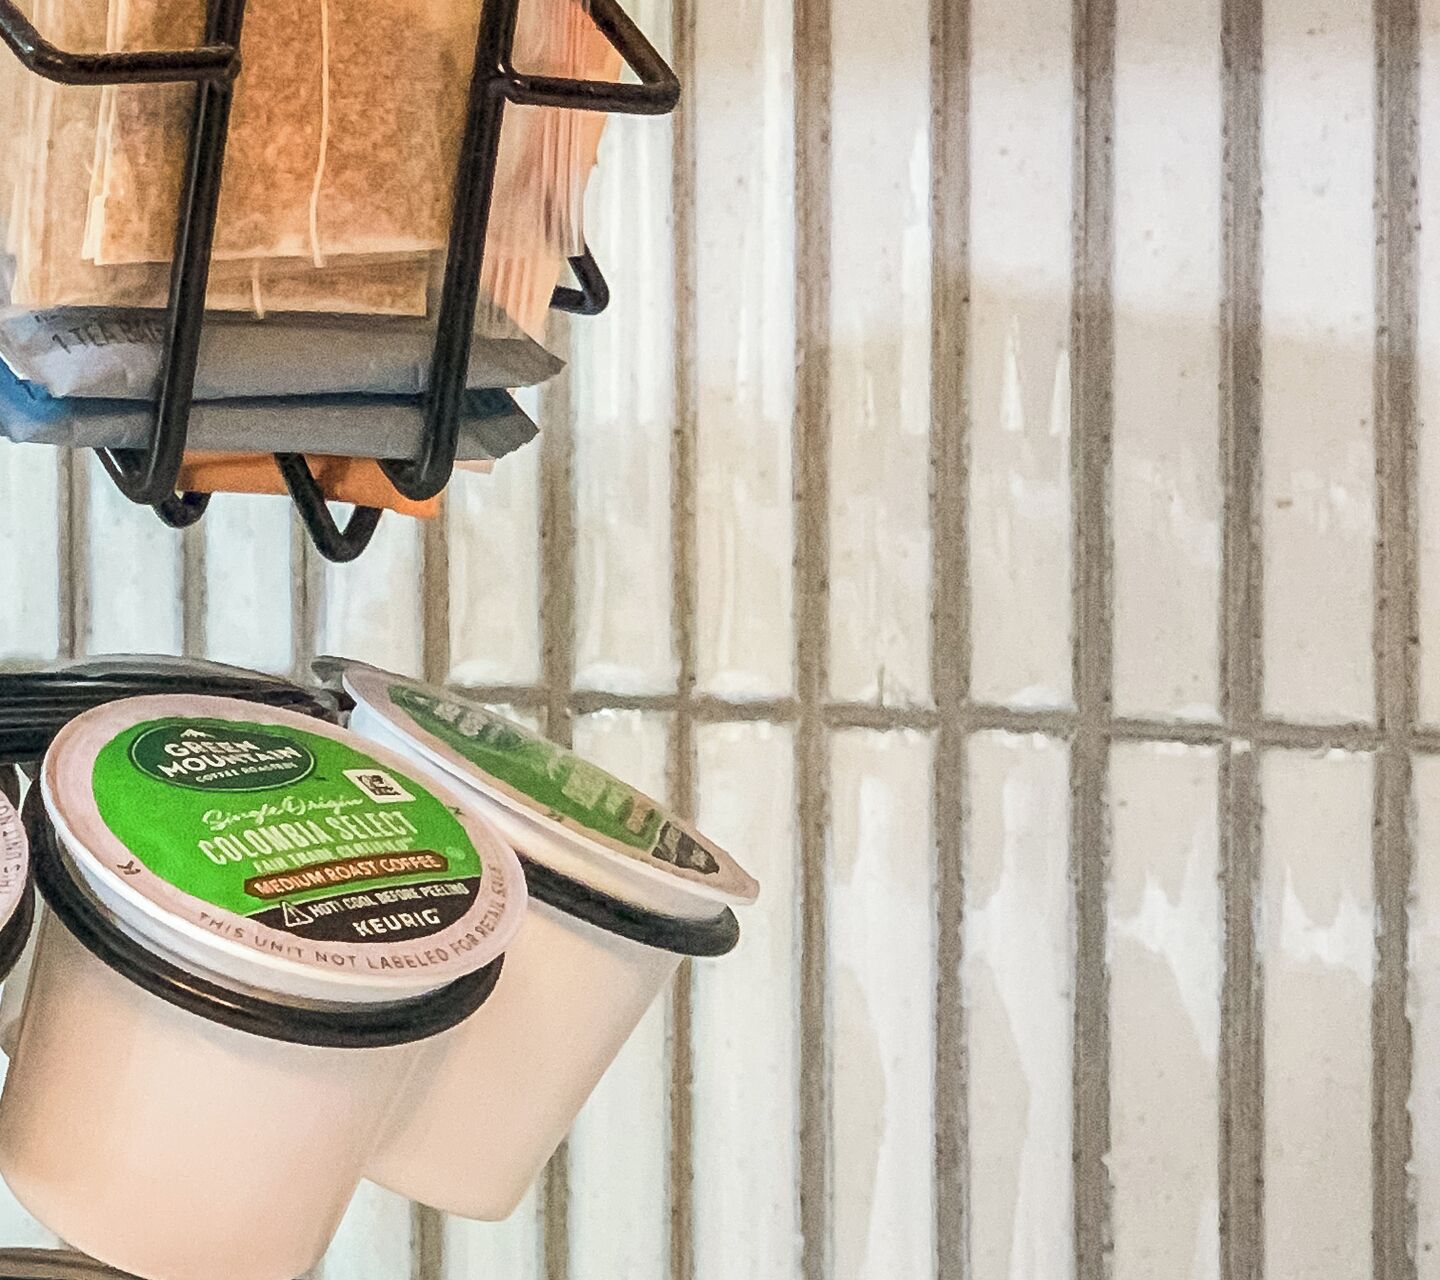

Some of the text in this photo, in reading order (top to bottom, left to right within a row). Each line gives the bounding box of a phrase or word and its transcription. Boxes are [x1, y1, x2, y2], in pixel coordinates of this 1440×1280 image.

[156, 745, 304, 778] MOUNTAIN
[163, 739, 261, 758] GREEN
[201, 795, 364, 832] Single Origin
[197, 809, 419, 866] COLOMBIA SELECT
[253, 854, 443, 895] MEDIUM ROAST COFFEE
[199, 911, 244, 939] THIS
[254, 935, 305, 958] UNIT
[315, 950, 358, 967] NOT
[365, 947, 450, 970] LABELED
[453, 932, 481, 956] FOR
[352, 909, 441, 937] KEURIG
